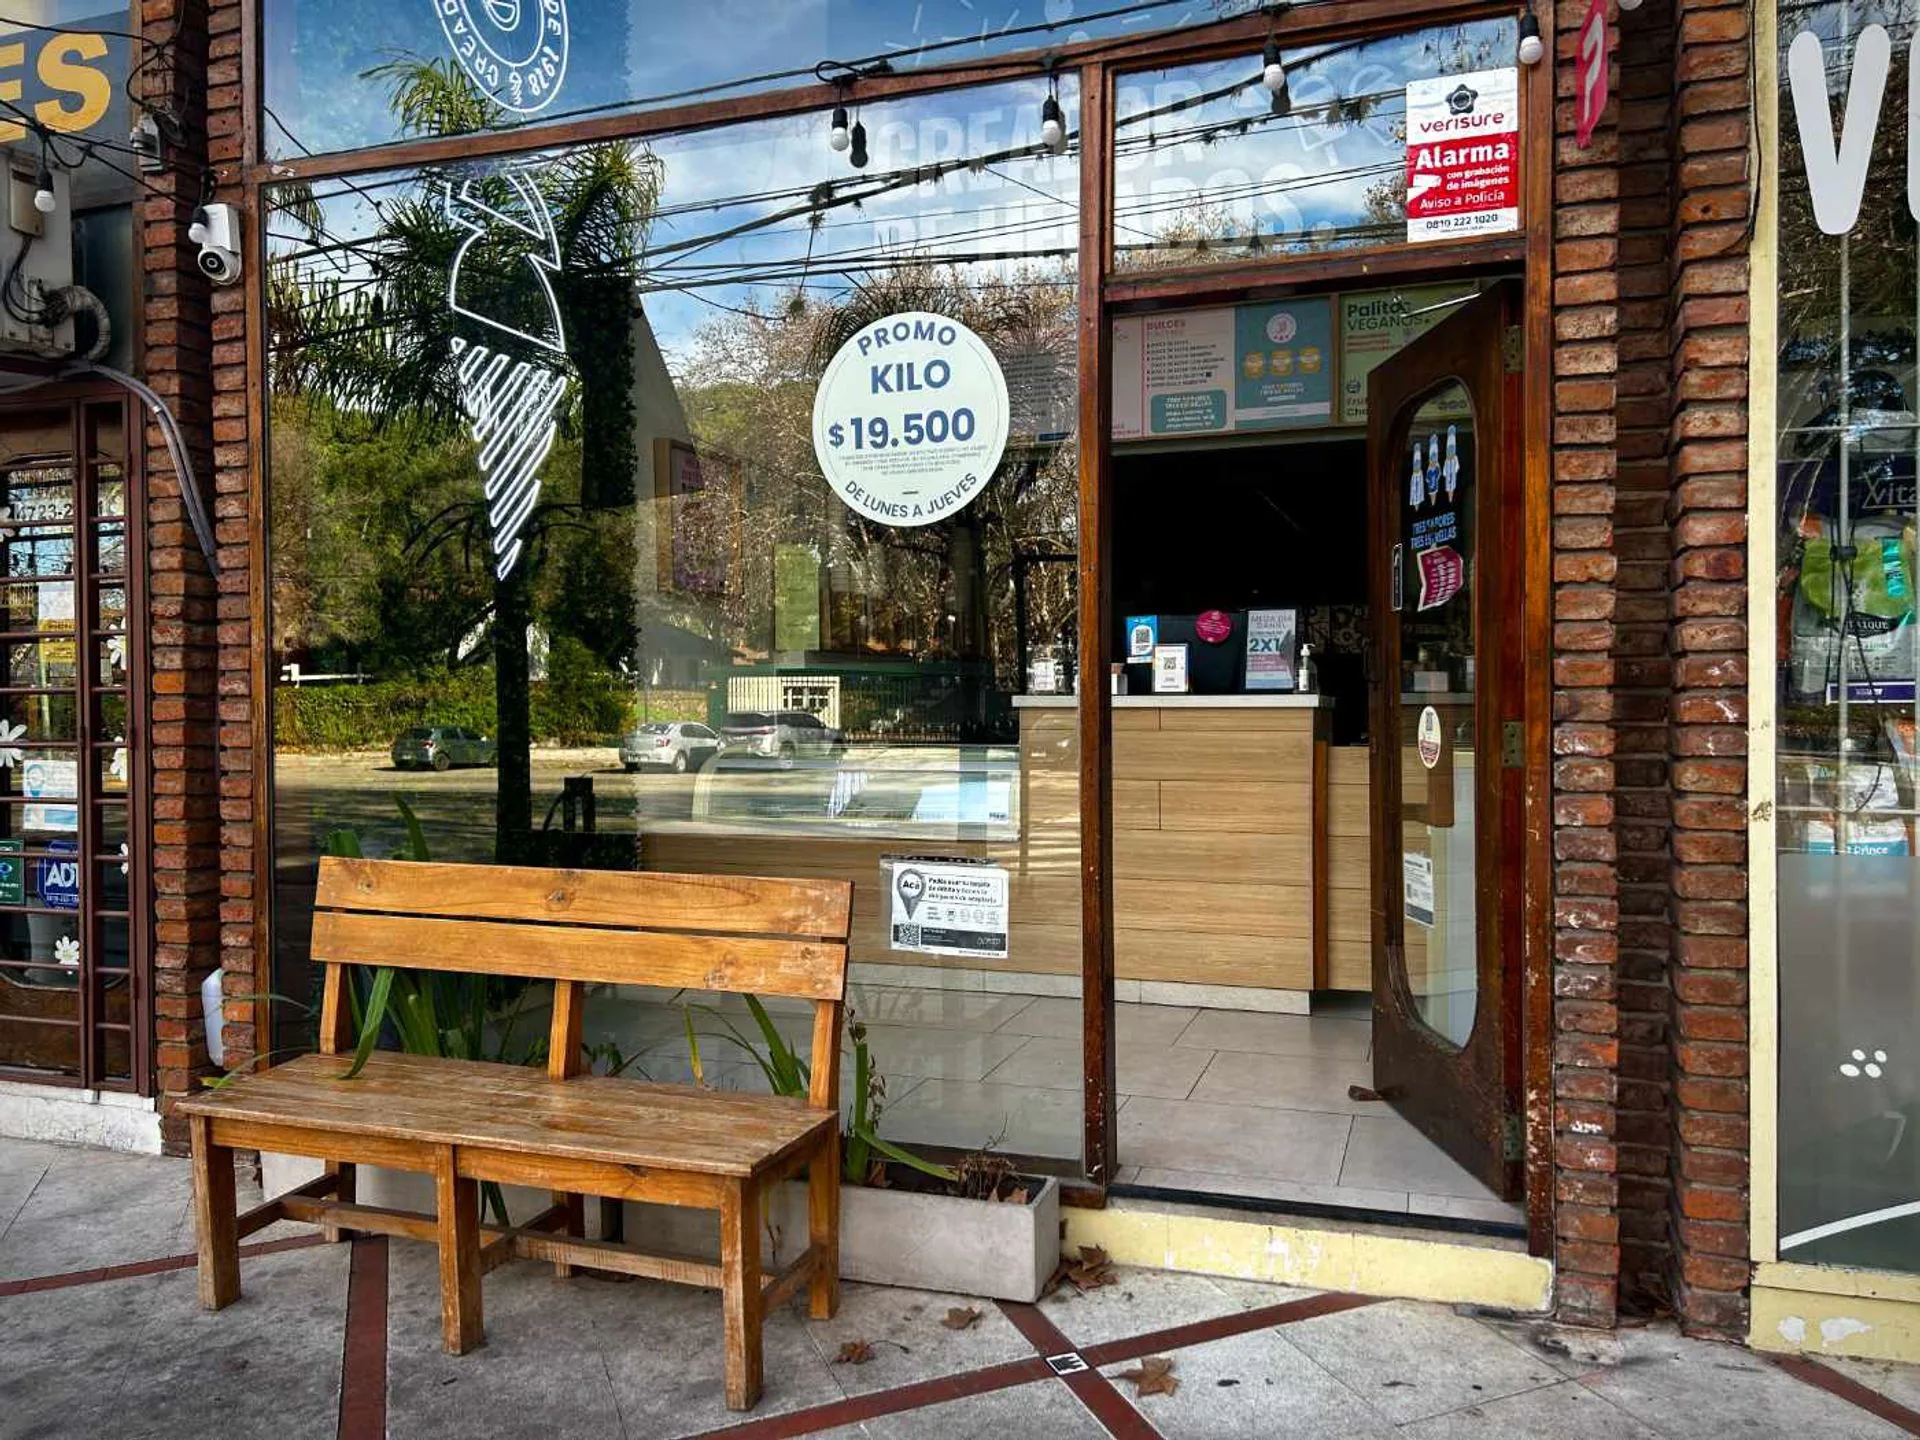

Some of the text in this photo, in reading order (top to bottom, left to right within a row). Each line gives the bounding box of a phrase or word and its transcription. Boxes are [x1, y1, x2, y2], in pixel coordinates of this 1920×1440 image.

[1420, 112, 1505, 133] verisure
[1788, 23, 1920, 235] V
[1416, 142, 1510, 171] Alarma
[1447, 164, 1510, 179] con grabación
[1447, 174, 1510, 190] de imágenes
[1420, 190, 1505, 210] Aviso a Policía
[1426, 219, 1451, 229] 0810
[1454, 216, 1472, 226] 222
[1474, 213, 1498, 224] 1020
[857, 320, 957, 356] PROMO
[871, 359, 950, 394] KILO
[828, 407, 975, 450] $19.500
[845, 472, 977, 518] DE LUNES A JUEVES
